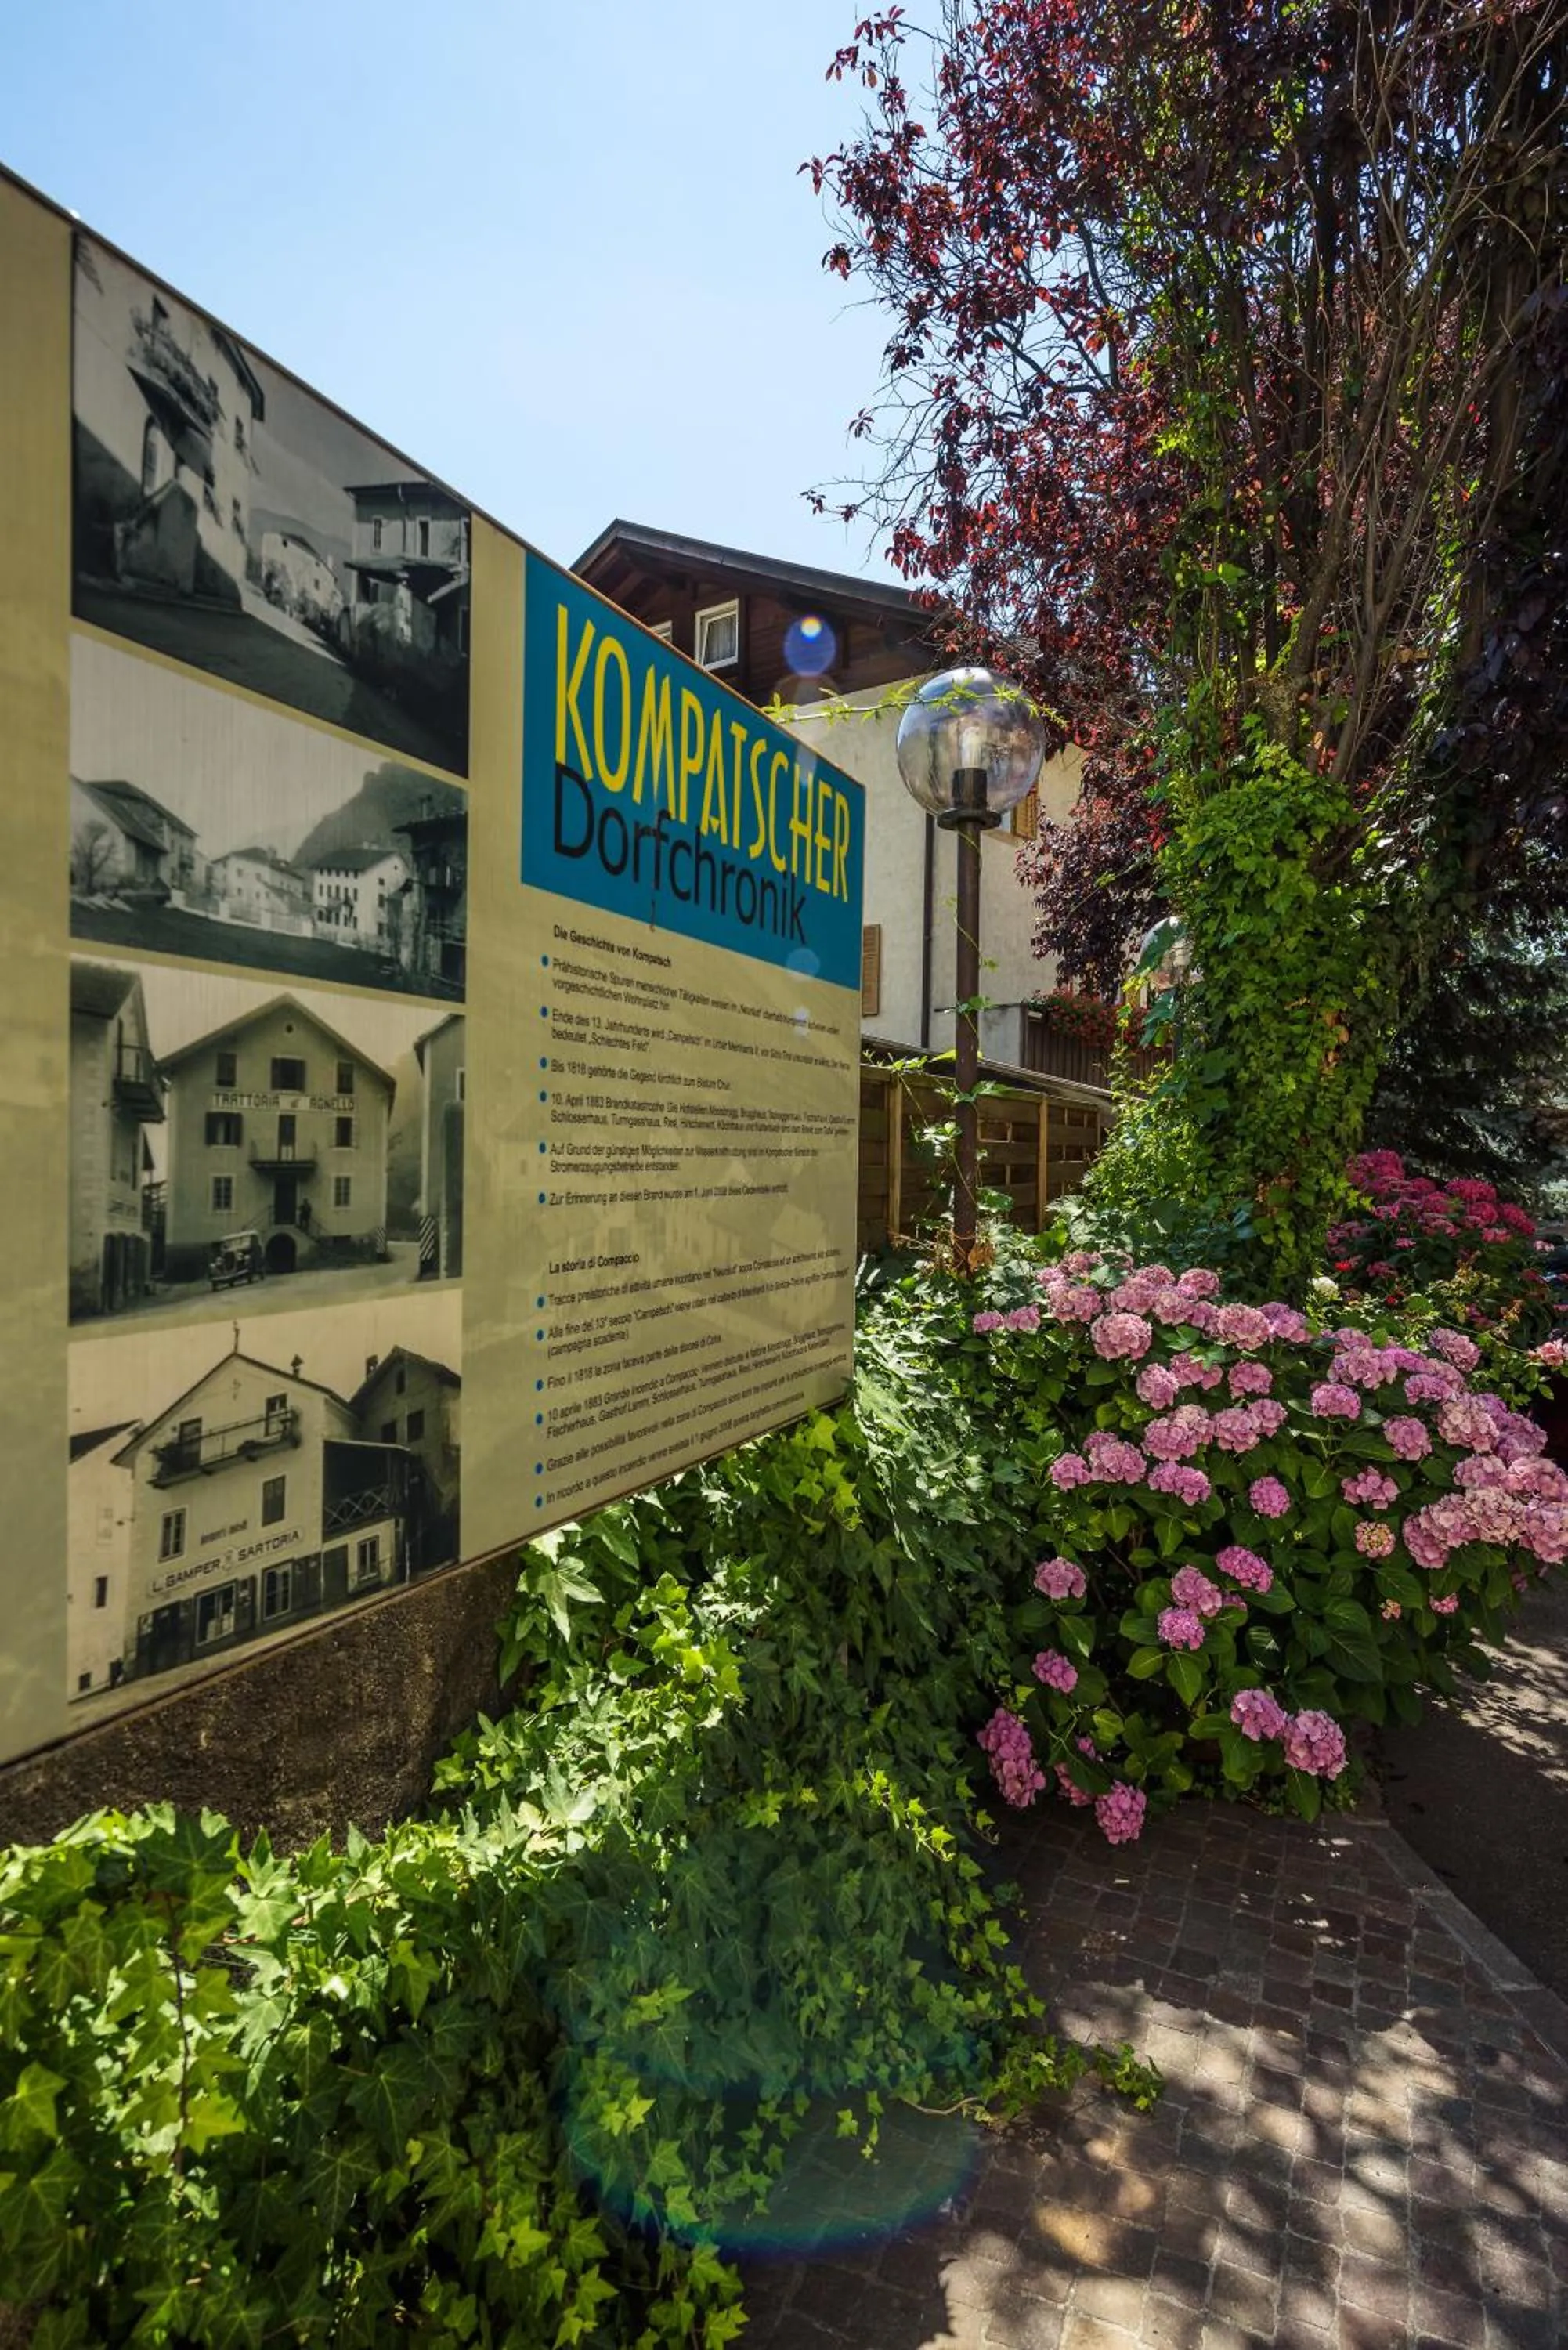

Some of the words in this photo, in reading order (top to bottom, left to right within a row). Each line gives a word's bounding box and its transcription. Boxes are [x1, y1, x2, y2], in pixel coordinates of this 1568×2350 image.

[555, 604, 850, 902] KOMPATSCHER
[555, 764, 807, 944] Dorfchronik
[165, 1557, 221, 1589] GAMPER
[237, 1530, 299, 1562] SARTORIA
